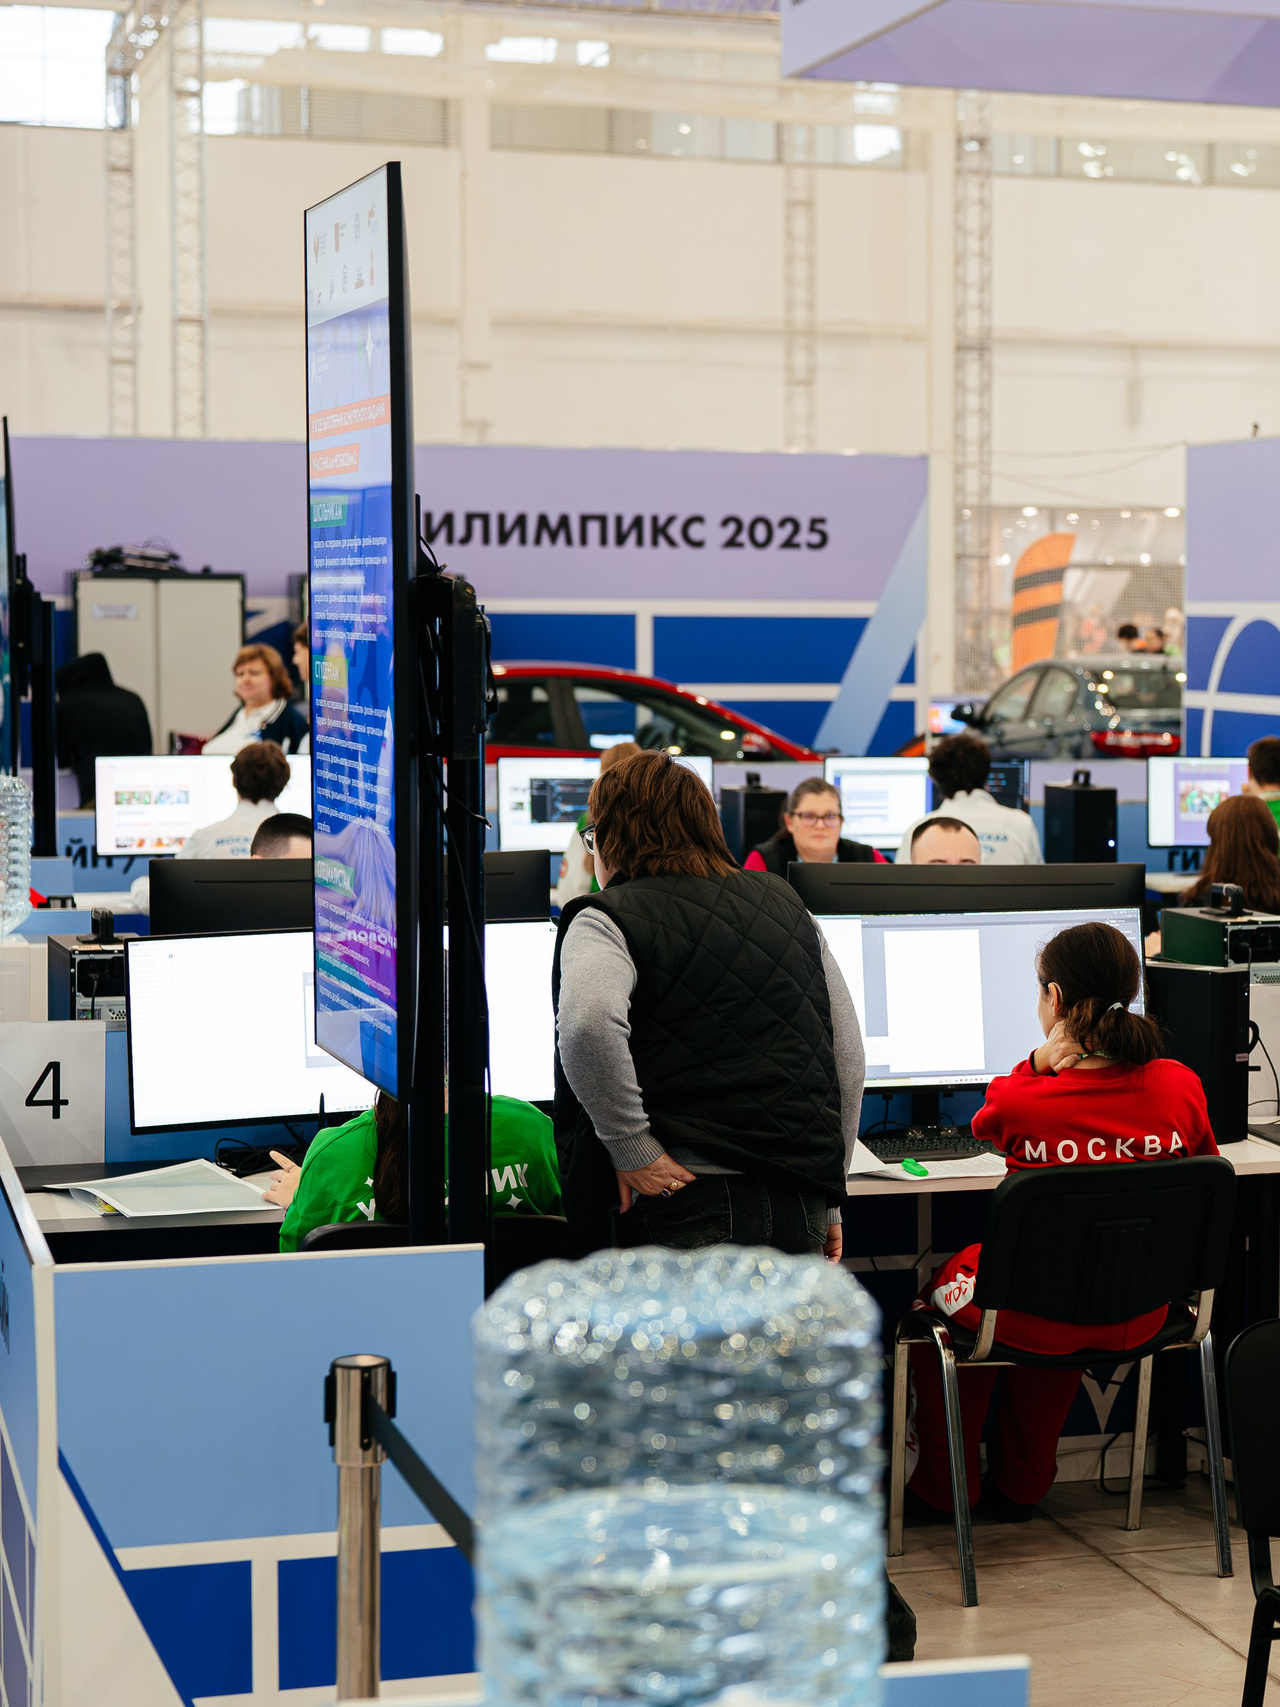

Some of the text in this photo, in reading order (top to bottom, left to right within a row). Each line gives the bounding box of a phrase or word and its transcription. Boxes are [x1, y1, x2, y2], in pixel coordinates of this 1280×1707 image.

[721, 515, 829, 549] 2025
[25, 1061, 69, 1120] 4
[1024, 1131, 1183, 1163] МОСКВА
